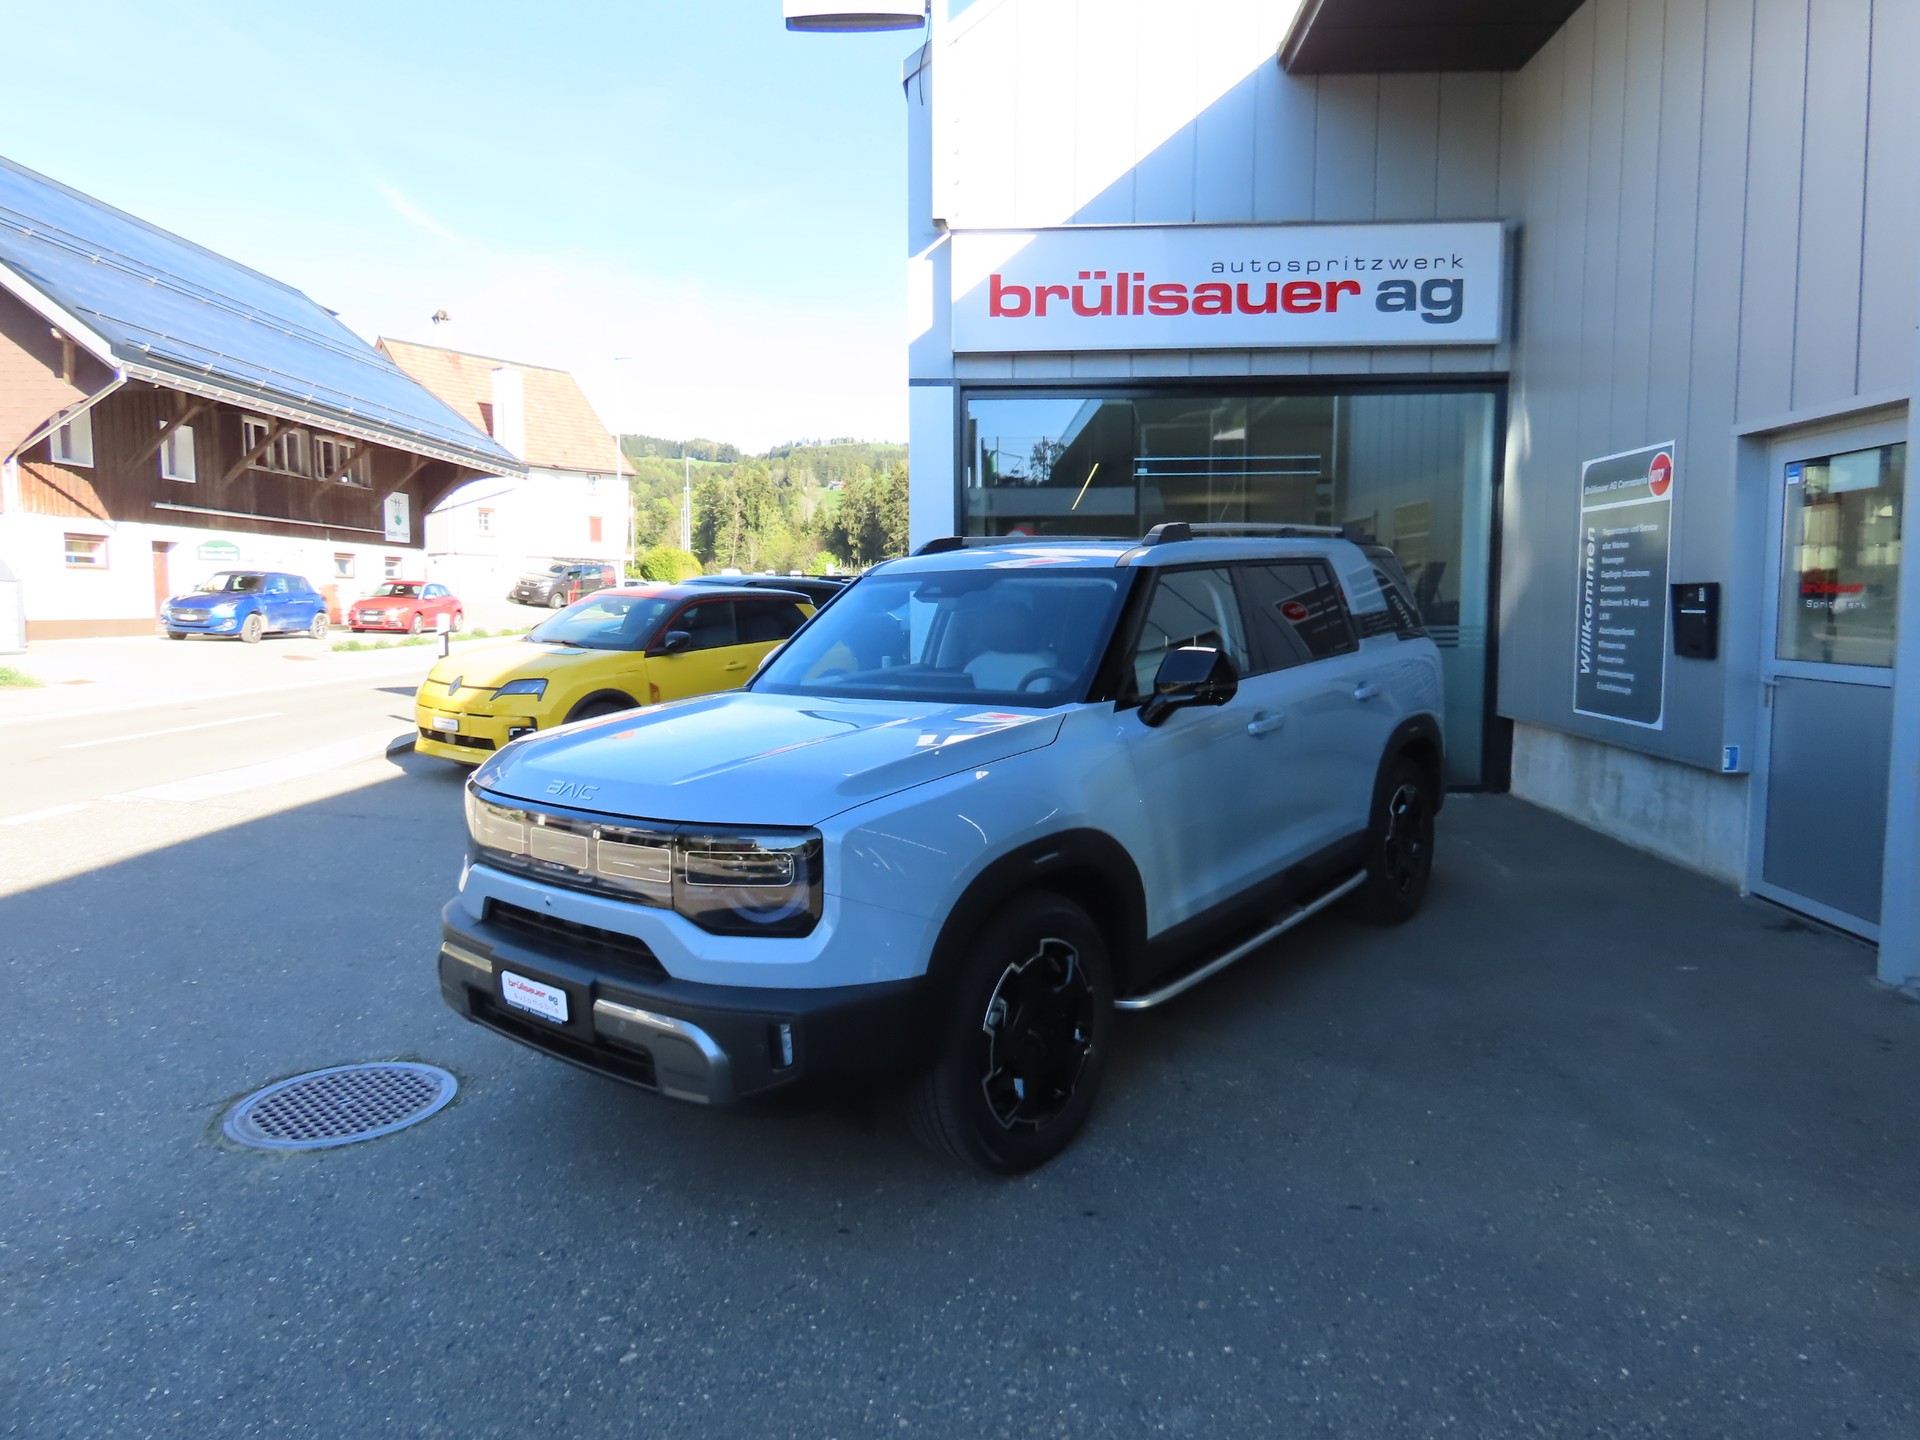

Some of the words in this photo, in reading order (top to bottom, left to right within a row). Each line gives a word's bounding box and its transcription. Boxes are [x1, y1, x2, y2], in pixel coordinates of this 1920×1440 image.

[1211, 253, 1464, 275] autospritzwerk
[989, 270, 1361, 318] brülisauer
[1375, 277, 1465, 324] ag
[1580, 527, 1596, 674] Willkommen
